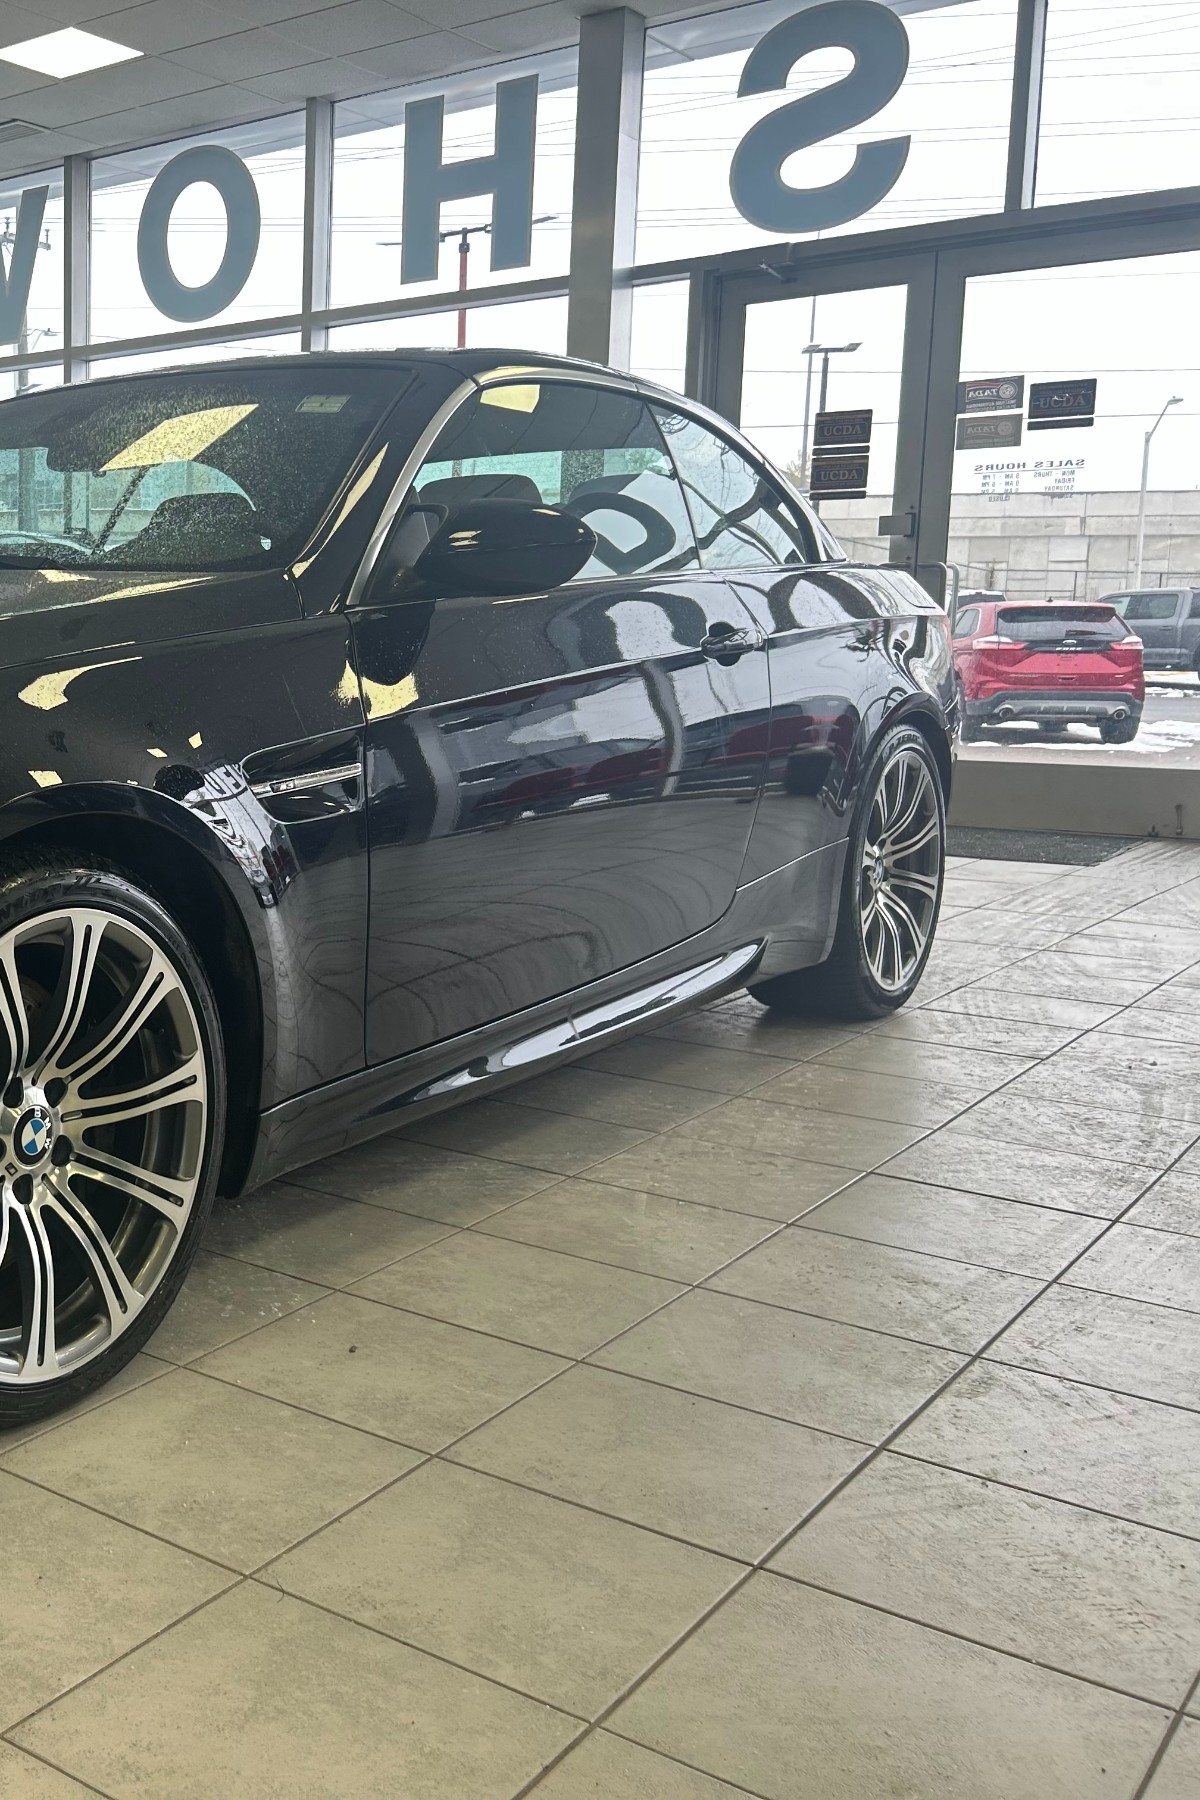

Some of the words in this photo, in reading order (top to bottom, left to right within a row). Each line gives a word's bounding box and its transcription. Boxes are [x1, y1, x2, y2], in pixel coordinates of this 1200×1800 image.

[1039, 395, 1086, 408] UCDA
[824, 425, 862, 436] UCDA
[820, 469, 858, 481] UCDA
